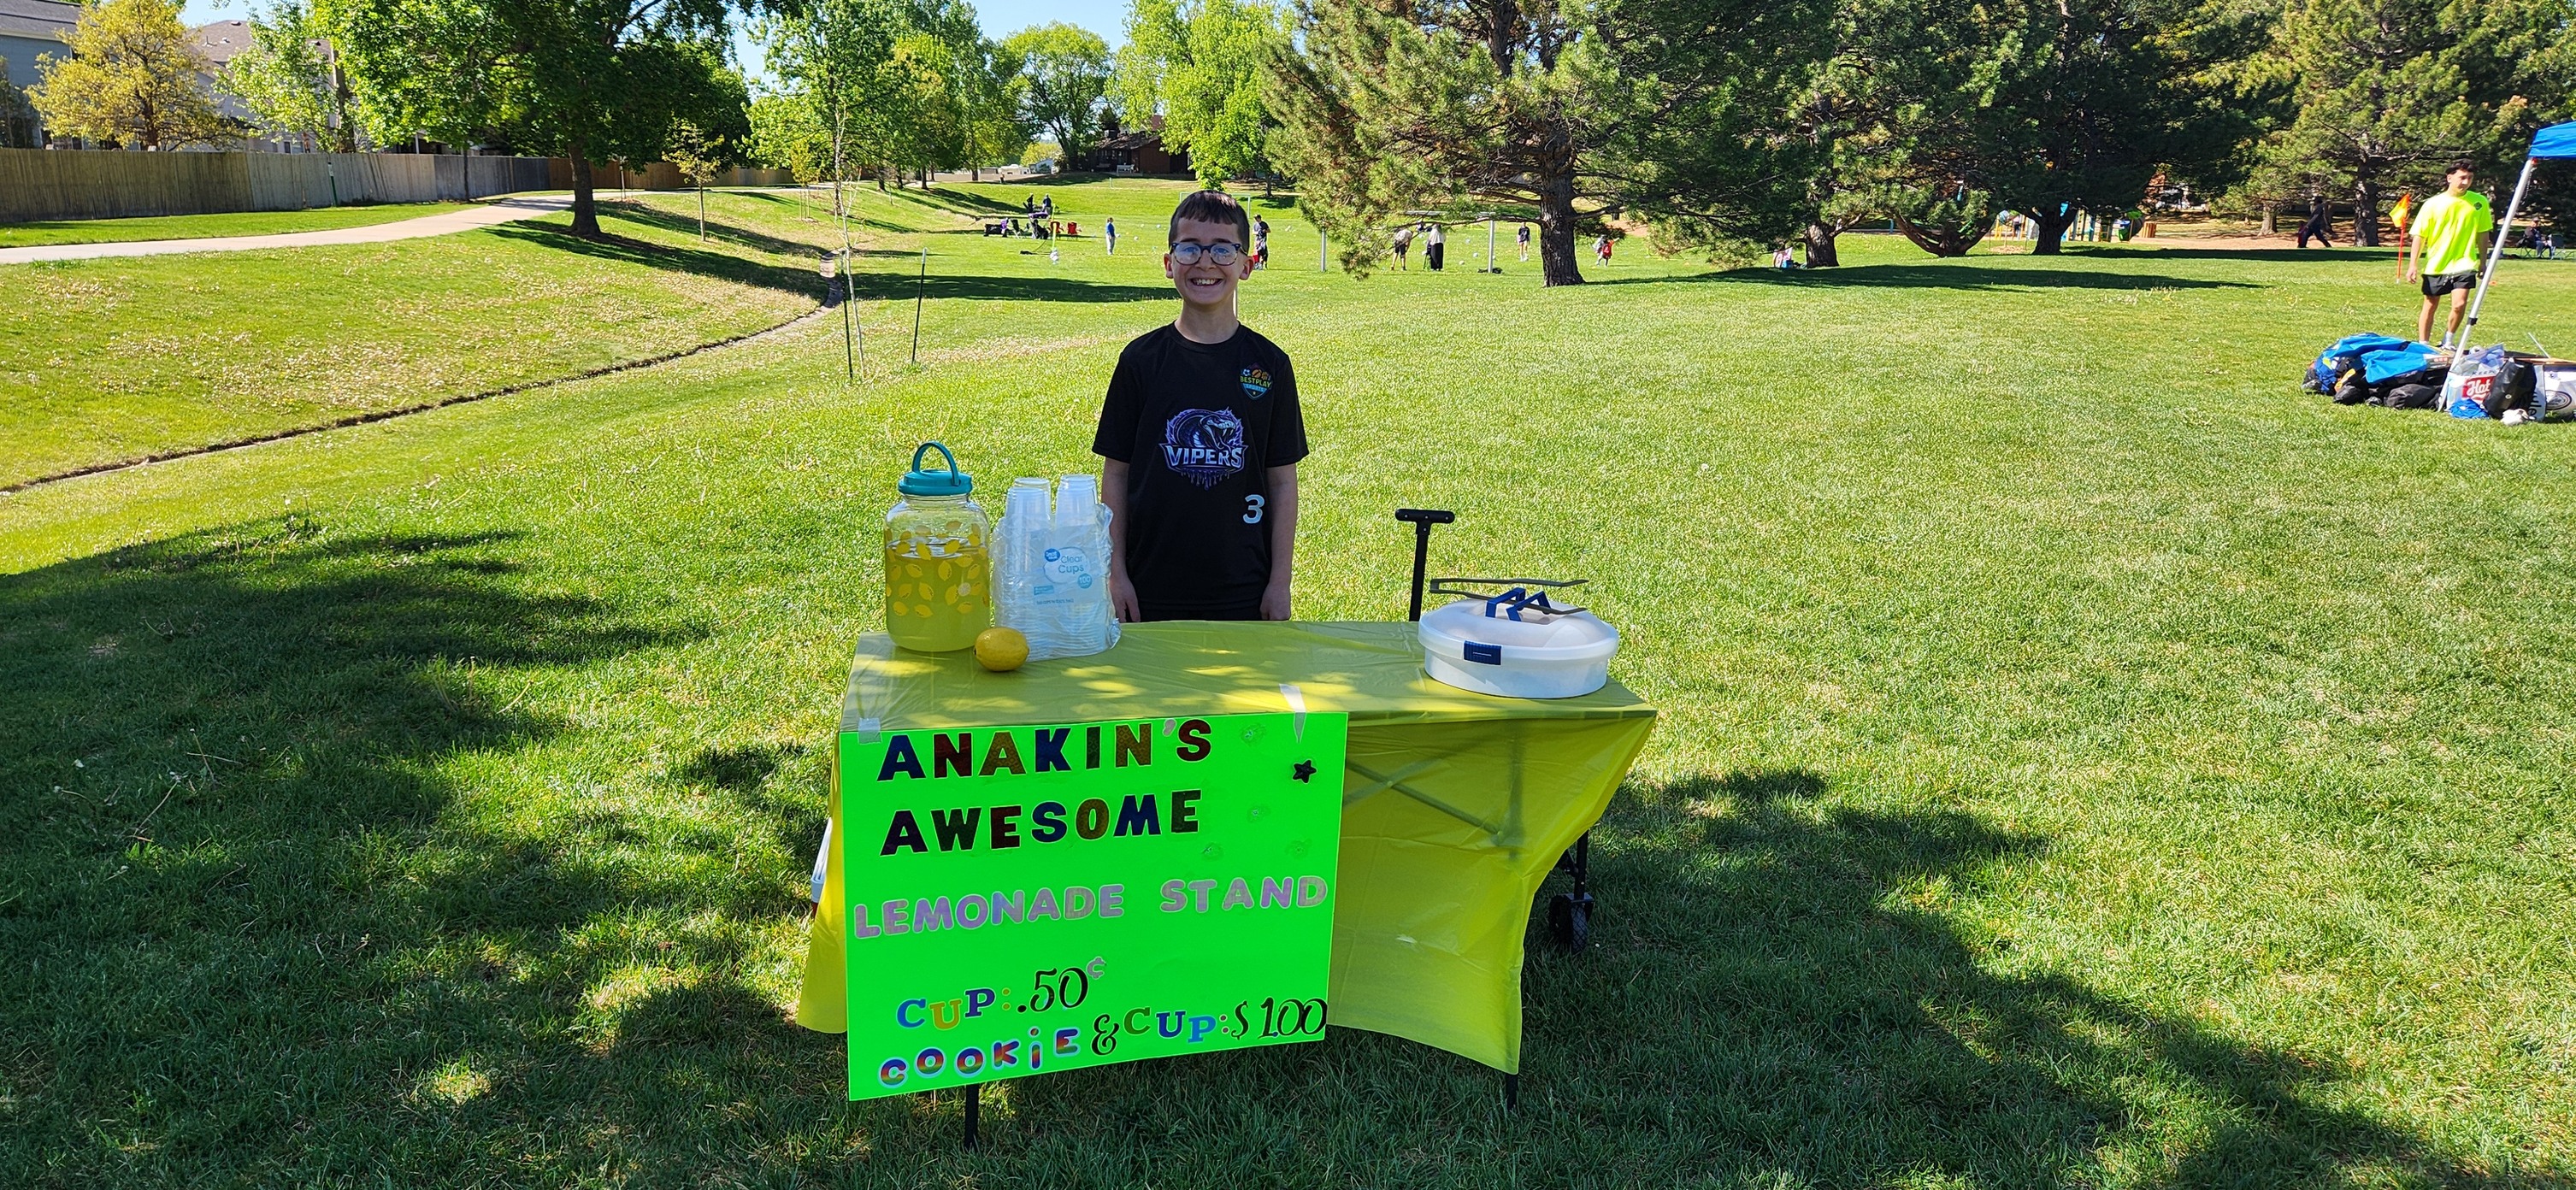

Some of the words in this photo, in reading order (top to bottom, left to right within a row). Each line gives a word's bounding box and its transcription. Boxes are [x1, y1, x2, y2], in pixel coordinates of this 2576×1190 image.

[1240, 375, 1272, 388] BESTPLAY
[2467, 380, 2491, 396] Hot
[1166, 445, 1244, 468] VIPERS
[1242, 493, 1265, 524] 3
[1058, 565, 1084, 574] Cups
[877, 718, 1212, 781] ANAKIN'S
[879, 789, 1202, 857] AWESOME
[854, 884, 1125, 940] LEMONADE
[1159, 875, 1328, 913] STAND
